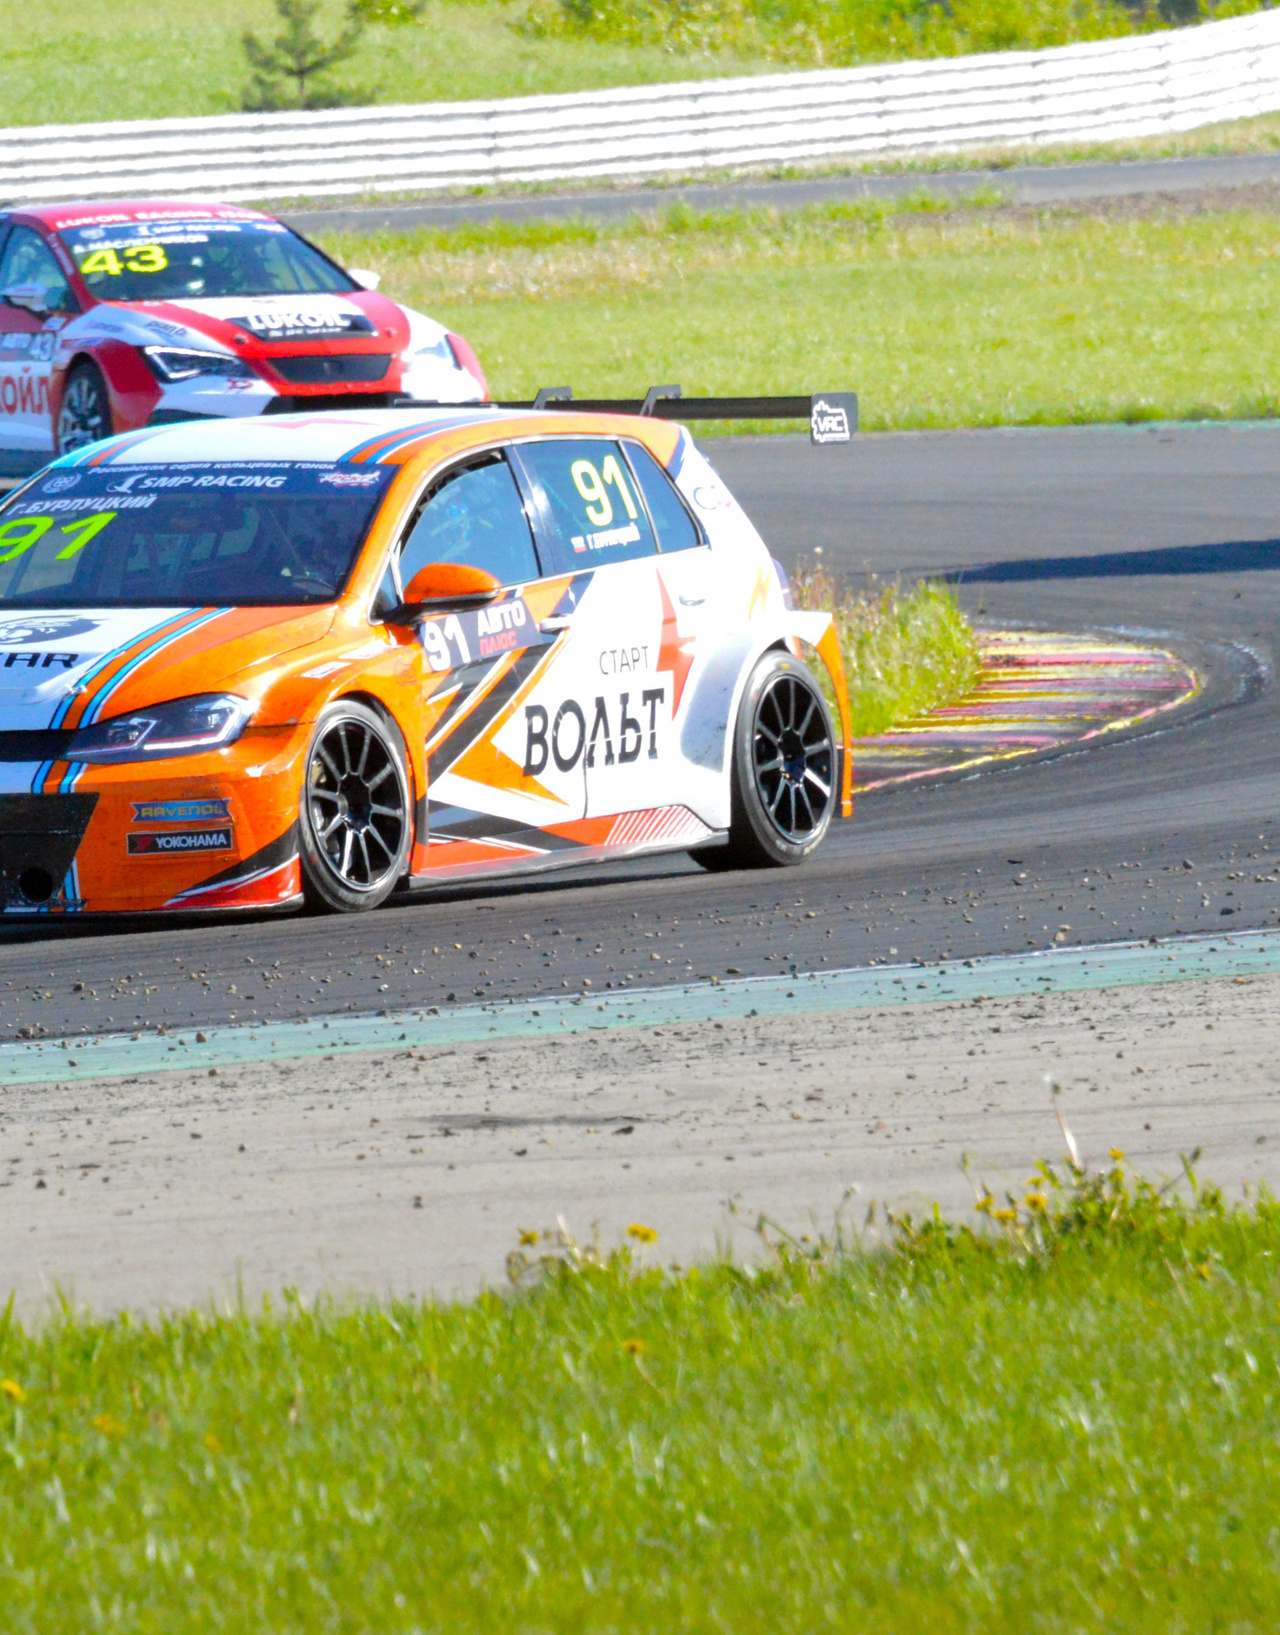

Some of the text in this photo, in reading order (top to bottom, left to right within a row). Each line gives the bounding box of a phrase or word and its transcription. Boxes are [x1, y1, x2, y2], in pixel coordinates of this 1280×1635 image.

[80, 244, 169, 275] 43
[247, 311, 351, 330] LUKOIL
[29, 332, 56, 361] 43
[816, 415, 844, 432] VRC
[138, 475, 288, 489] SMP RACING
[571, 454, 638, 527] 91
[477, 600, 526, 638] АВТО
[424, 613, 470, 672] 91
[479, 630, 518, 656] ПЛЮС
[599, 646, 649, 675] СТАРТ
[523, 687, 665, 777] ВОЛЬТ
[141, 804, 224, 818] RAVENOL
[155, 832, 228, 849] YOKOHAMA
